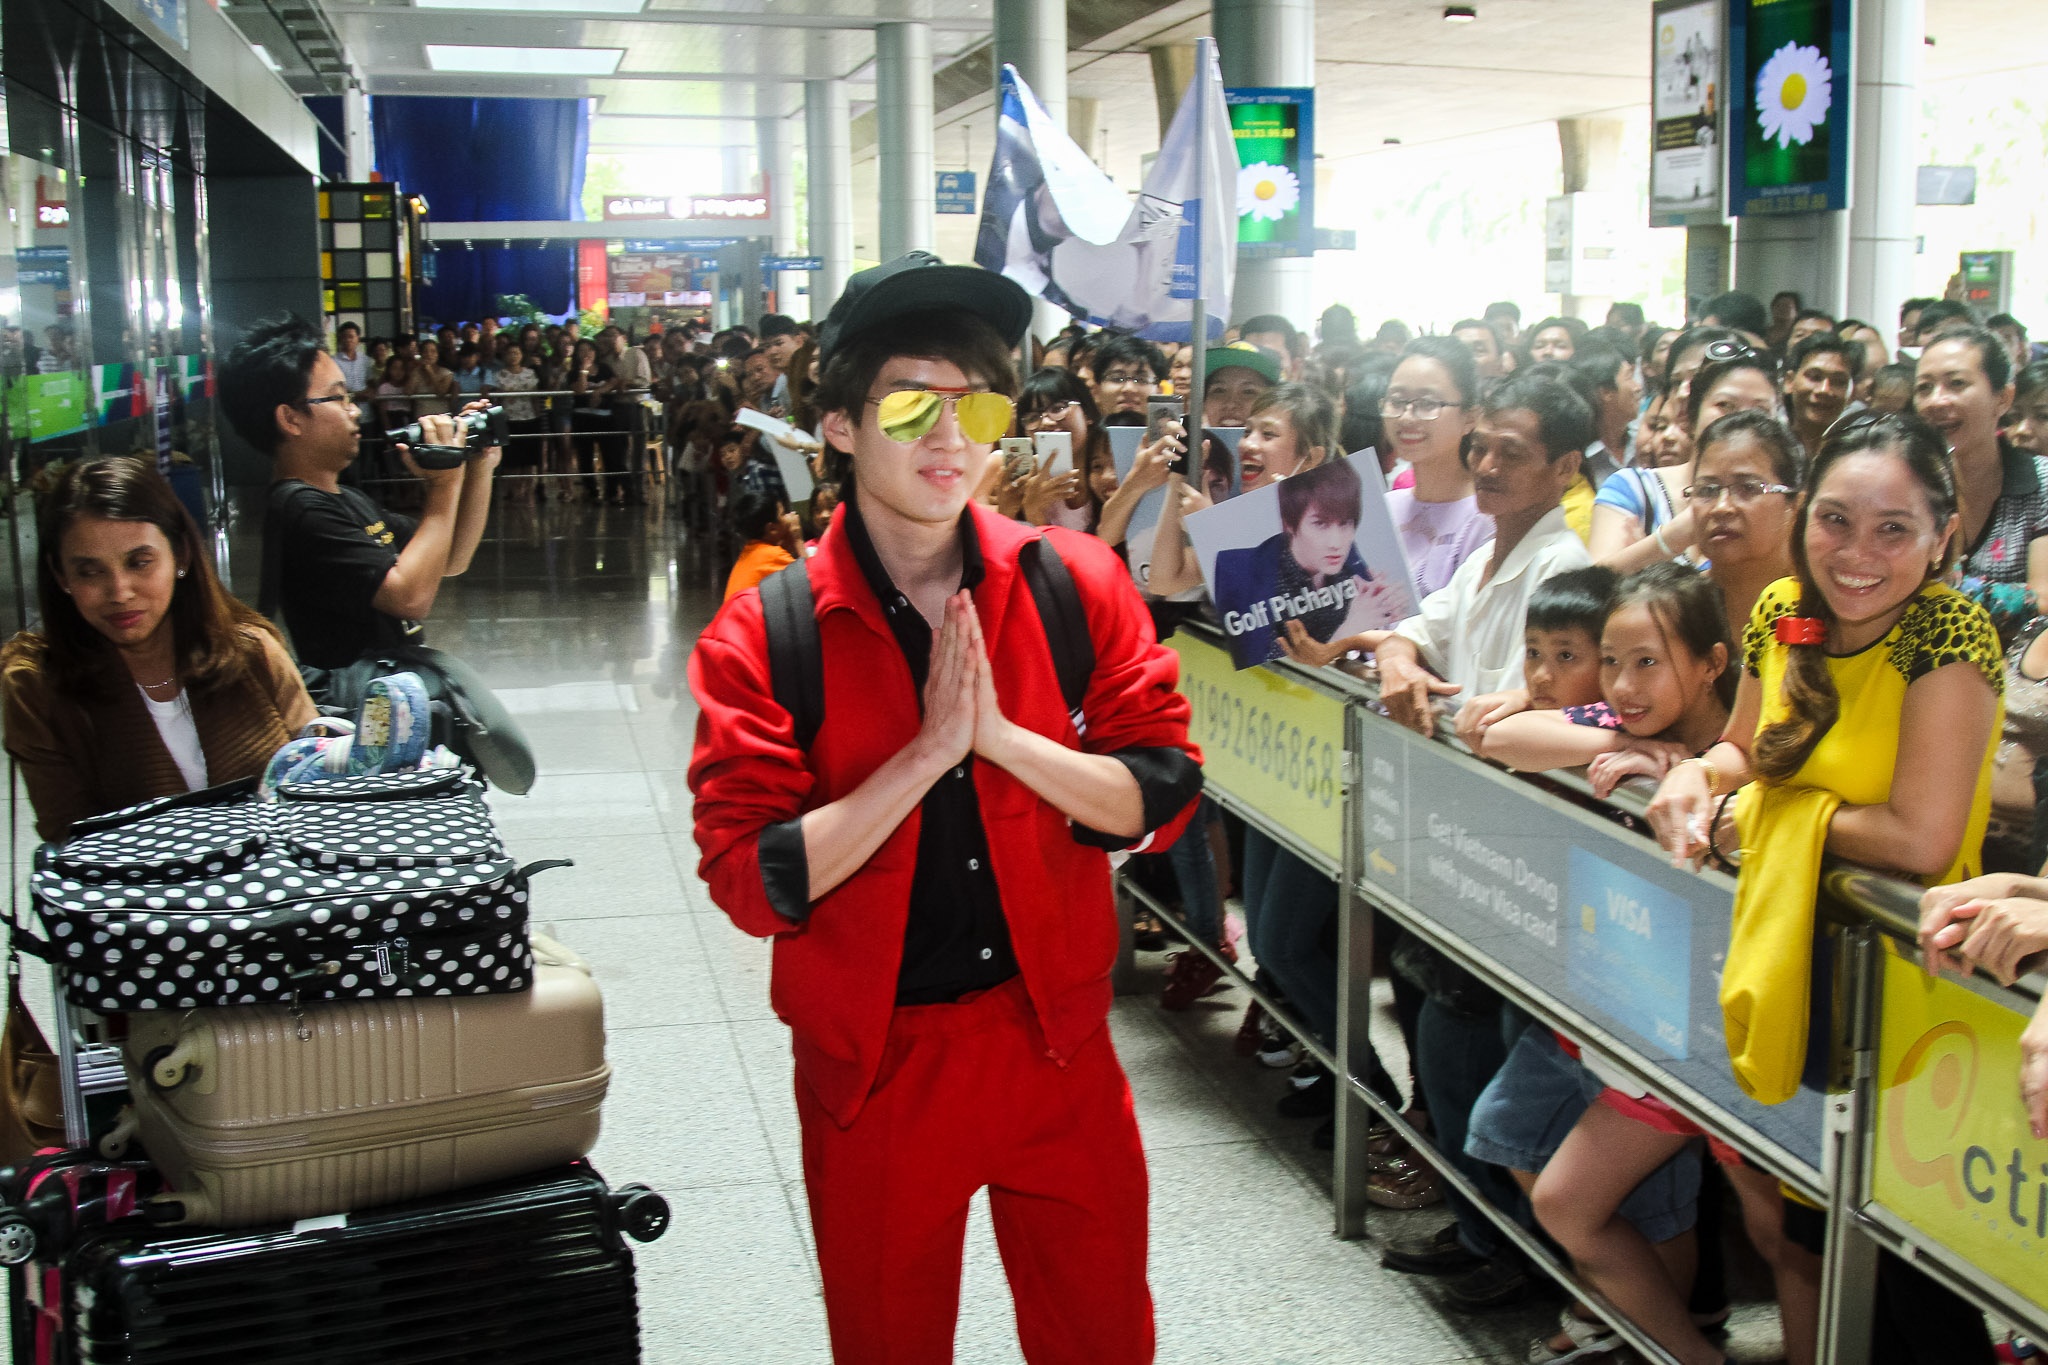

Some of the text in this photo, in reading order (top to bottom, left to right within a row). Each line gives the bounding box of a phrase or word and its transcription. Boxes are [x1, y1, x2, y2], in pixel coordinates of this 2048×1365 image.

[1935, 171, 1952, 200] 7
[1224, 579, 1359, 636] Golf Pichaya
[1514, 857, 1558, 912] Dong
[1523, 912, 1557, 947] card
[1606, 886, 1652, 940] VISA
